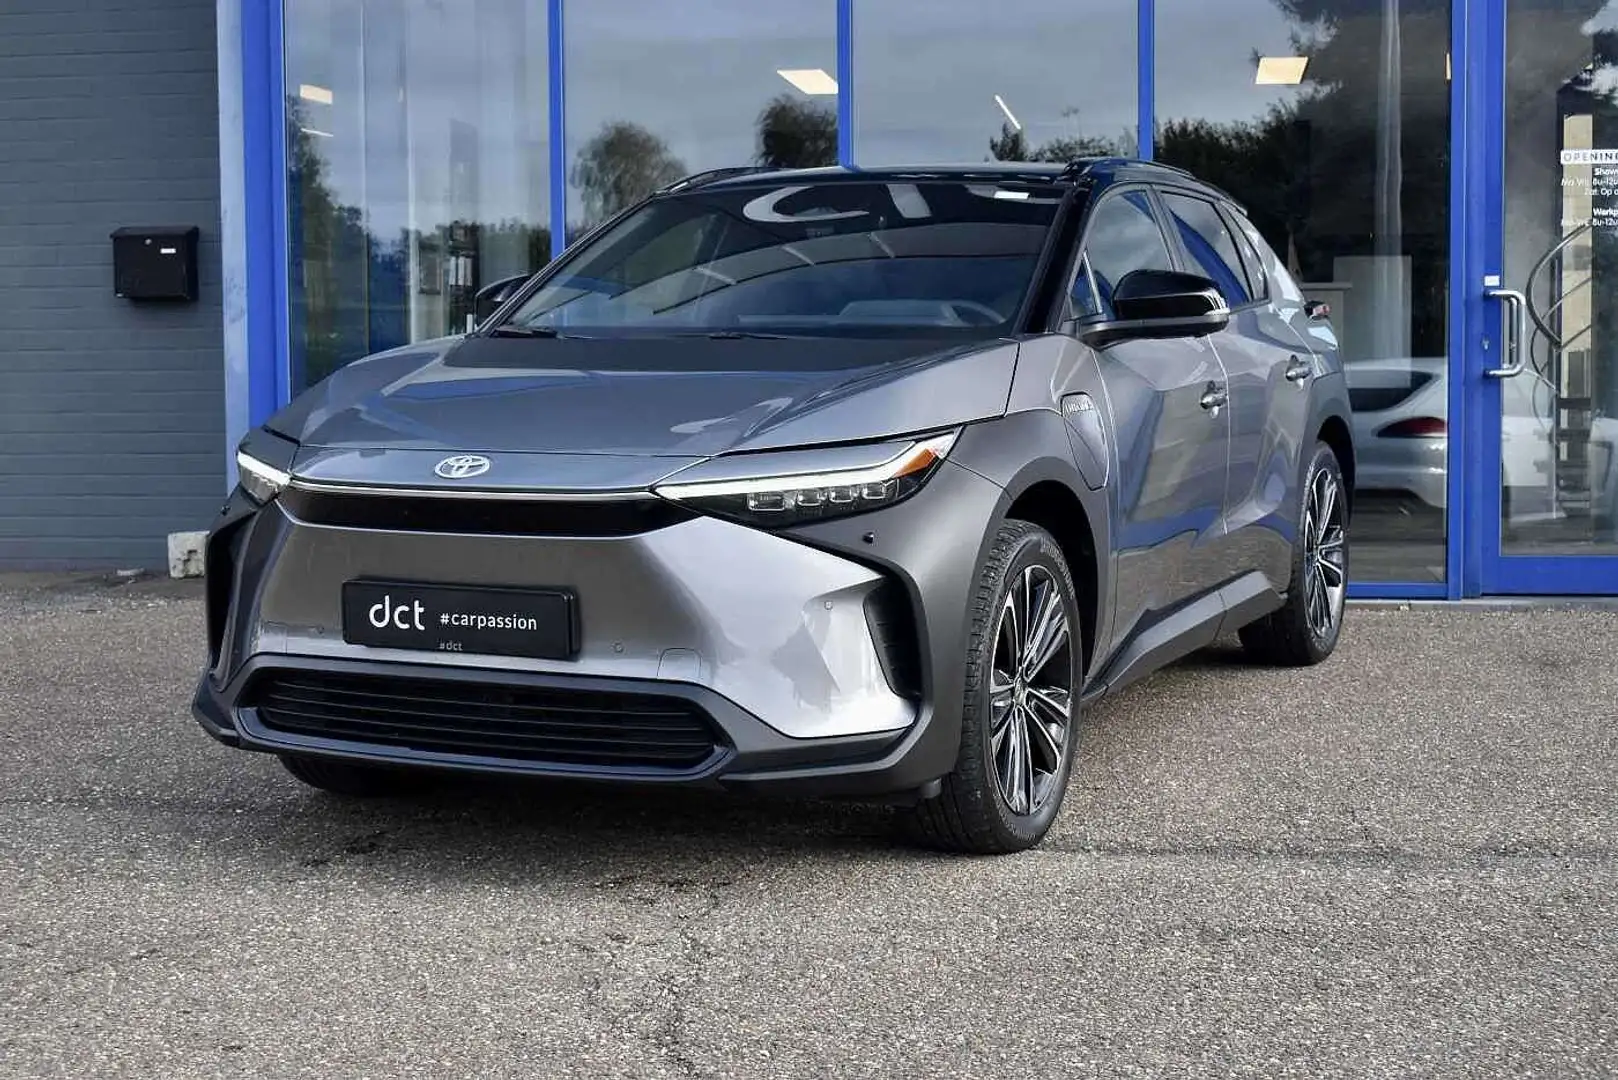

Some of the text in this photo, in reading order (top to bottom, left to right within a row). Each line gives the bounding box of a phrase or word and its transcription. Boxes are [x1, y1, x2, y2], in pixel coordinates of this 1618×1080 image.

[1600, 188, 1613, 198] Op
[368, 594, 538, 631] dct #carpassion
